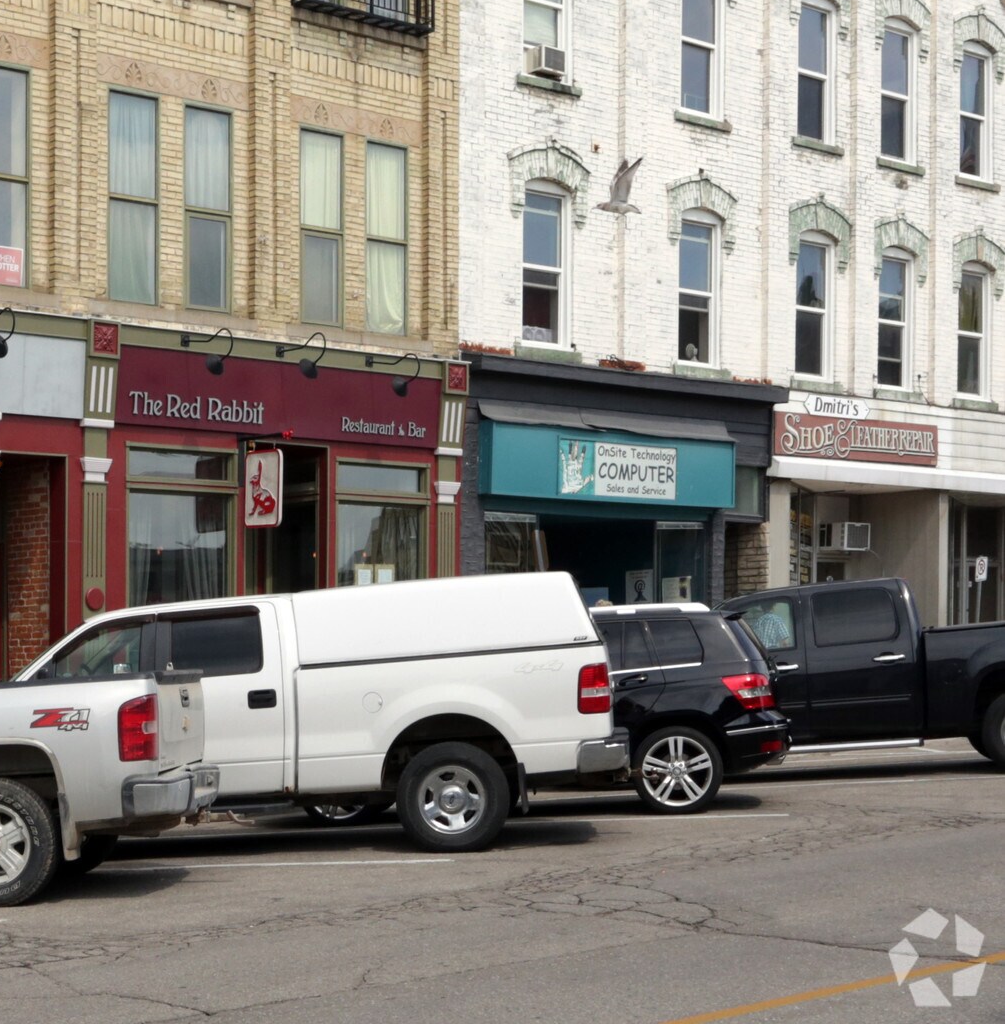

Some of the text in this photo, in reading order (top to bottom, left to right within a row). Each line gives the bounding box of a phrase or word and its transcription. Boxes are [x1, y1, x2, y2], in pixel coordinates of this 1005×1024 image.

[129, 391, 265, 425] The Red Rabbit
[814, 397, 859, 416] Dmitri's
[341, 416, 427, 438] Restaurant Bar
[780, 413, 835, 455] SHOE
[850, 424, 899, 451] LEATHER
[898, 429, 935, 453] REPAIR
[597, 445, 676, 465] OnSite Technology
[598, 462, 675, 484] COMPUTER
[606, 483, 667, 496] Sales and Service
